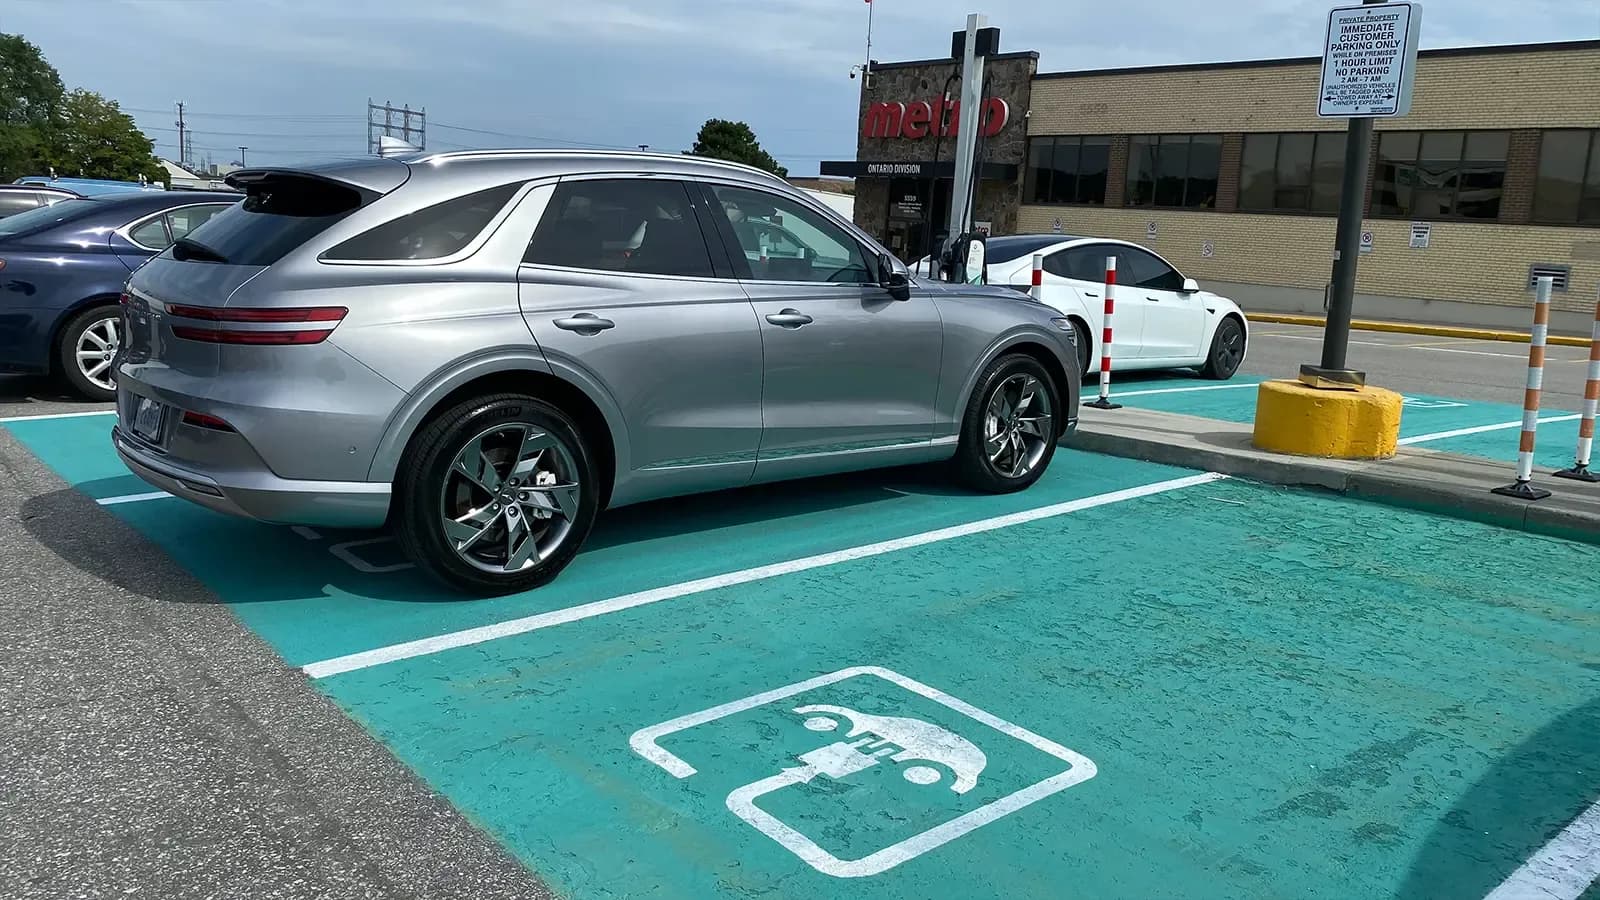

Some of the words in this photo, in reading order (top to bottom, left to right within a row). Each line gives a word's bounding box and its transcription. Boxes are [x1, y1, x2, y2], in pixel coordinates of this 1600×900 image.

[1341, 23, 1395, 33] IMMEDIATE
[1340, 32, 1394, 42] CUSTOMER
[1331, 42, 1372, 51] PARKING
[1376, 40, 1400, 48] ONLY
[1369, 57, 1394, 65] LIMIT
[1351, 67, 1389, 75] PARKING
[868, 163, 894, 174] ONTARIO
[894, 163, 921, 174] DIVISION
